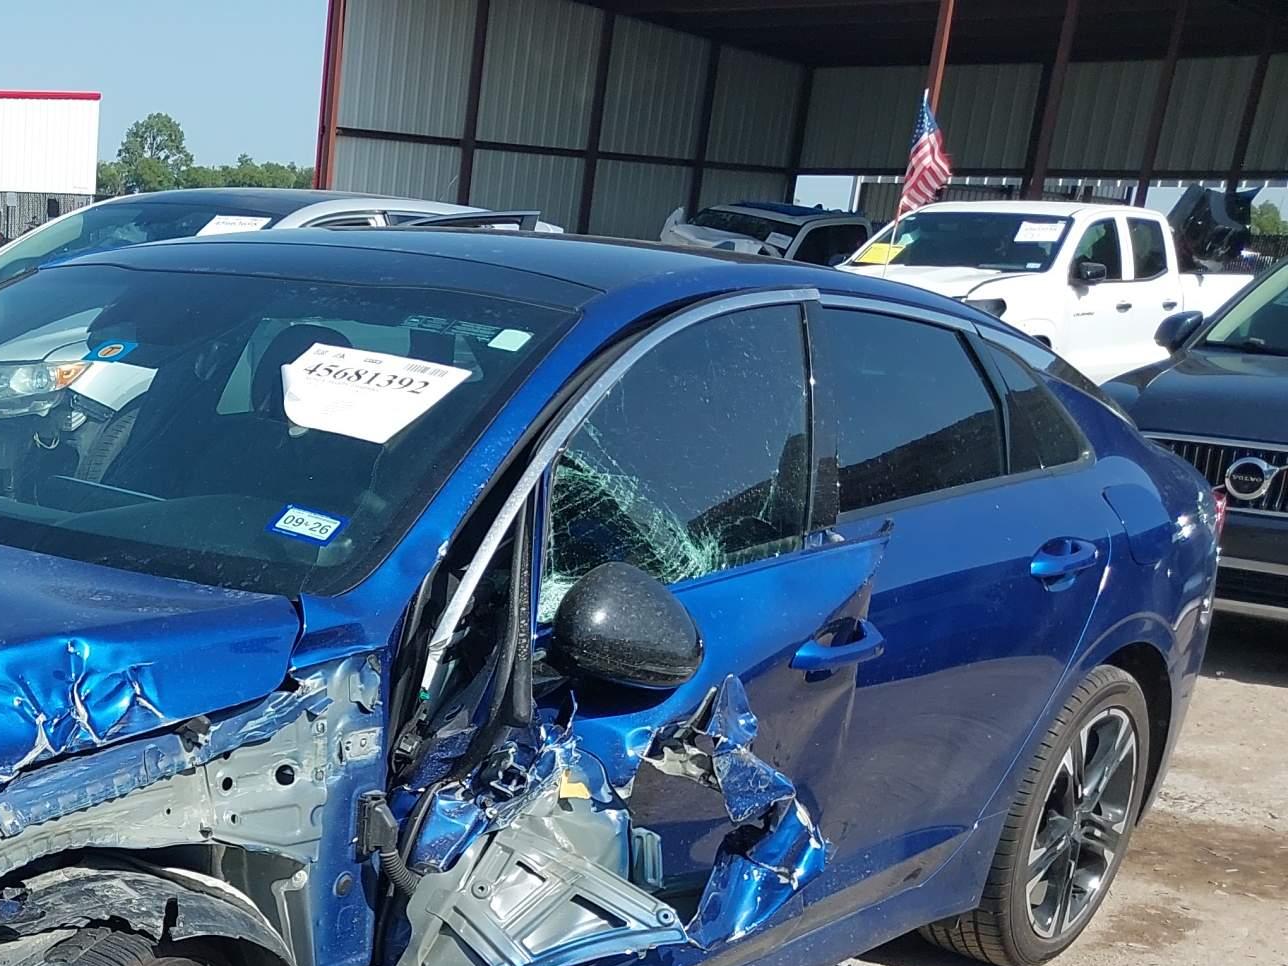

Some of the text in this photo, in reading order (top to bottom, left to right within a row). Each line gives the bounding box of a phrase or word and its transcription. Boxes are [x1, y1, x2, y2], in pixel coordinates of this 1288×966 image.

[304, 362, 430, 395] 45681392
[1232, 474, 1263, 483] VOLVO
[283, 514, 305, 527] 09
[308, 521, 332, 535] 26
